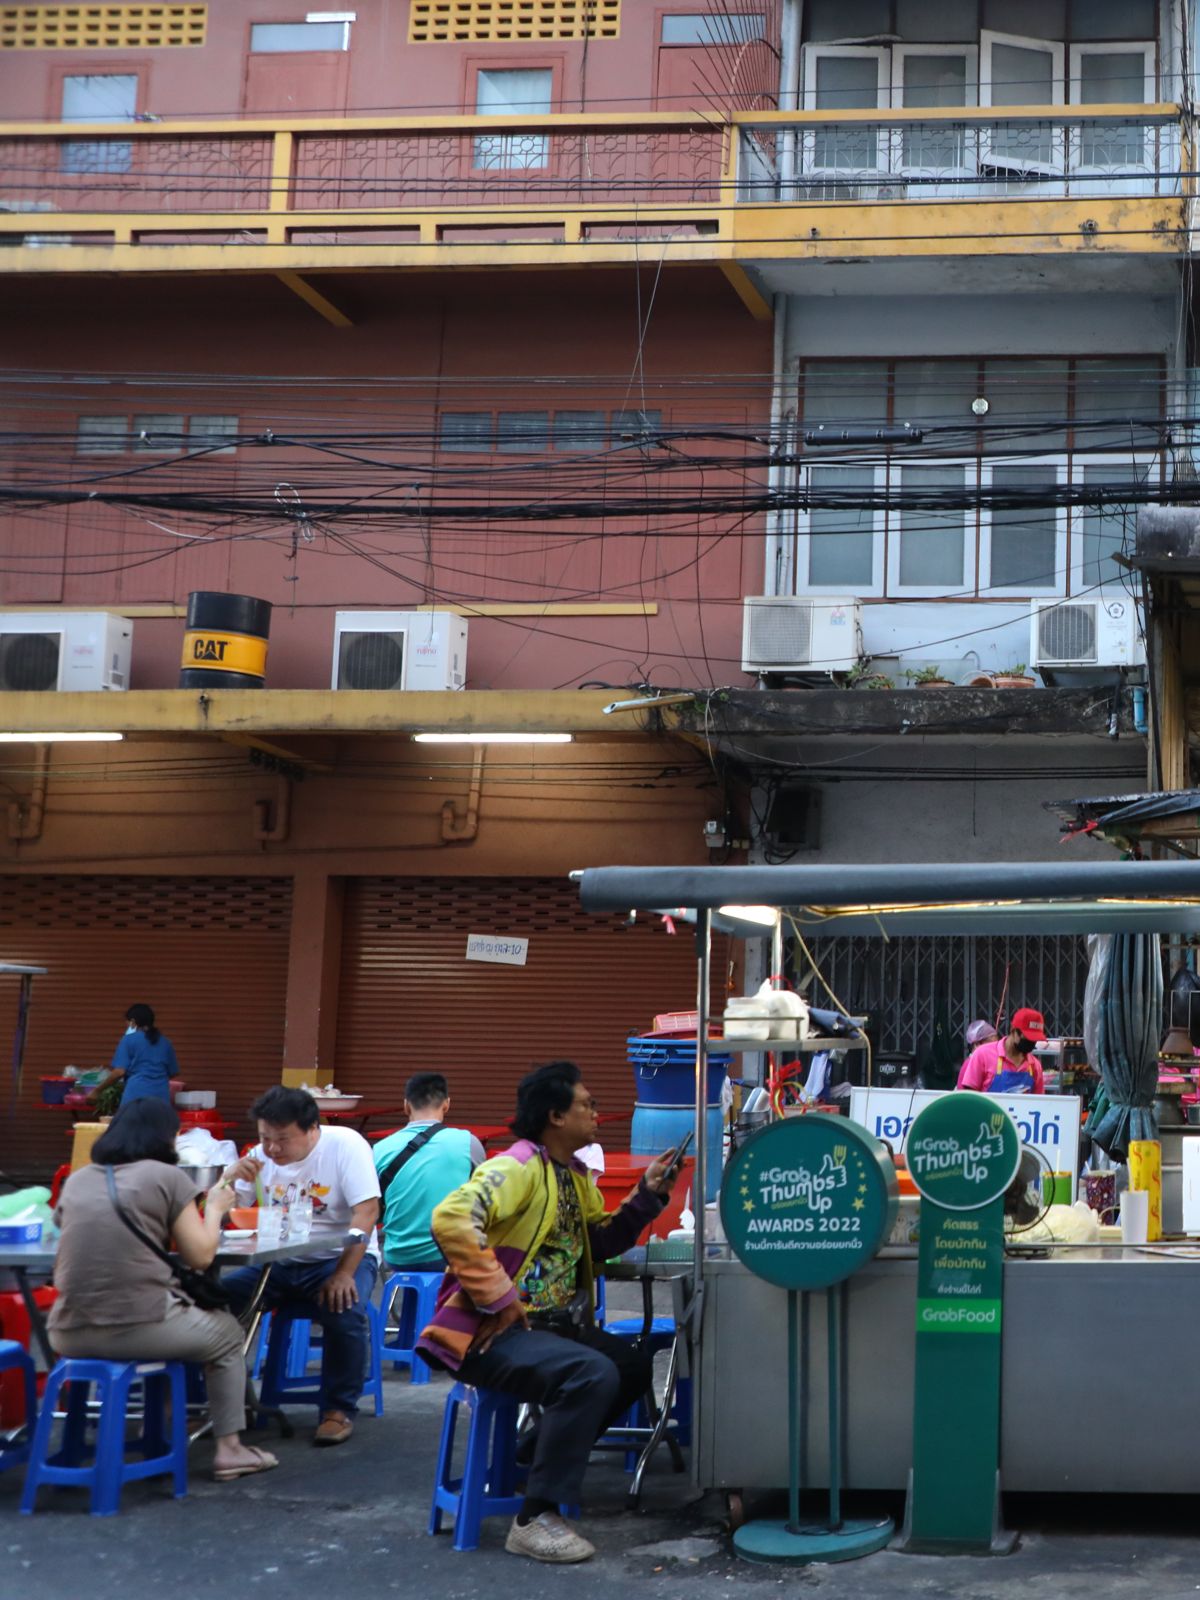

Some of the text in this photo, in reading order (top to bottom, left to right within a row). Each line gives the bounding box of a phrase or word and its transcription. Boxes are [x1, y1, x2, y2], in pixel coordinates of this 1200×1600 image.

[193, 639, 229, 661] CAT
[913, 1136, 960, 1152] #Grab
[914, 1143, 992, 1174] Thumbs
[759, 1165, 811, 1184] #Grab
[963, 1162, 989, 1184] Up
[759, 1173, 836, 1205] Thumbs
[808, 1194, 832, 1214] Up
[747, 1217, 861, 1233] AWARDS 2022
[922, 1307, 996, 1323] GrabFood
